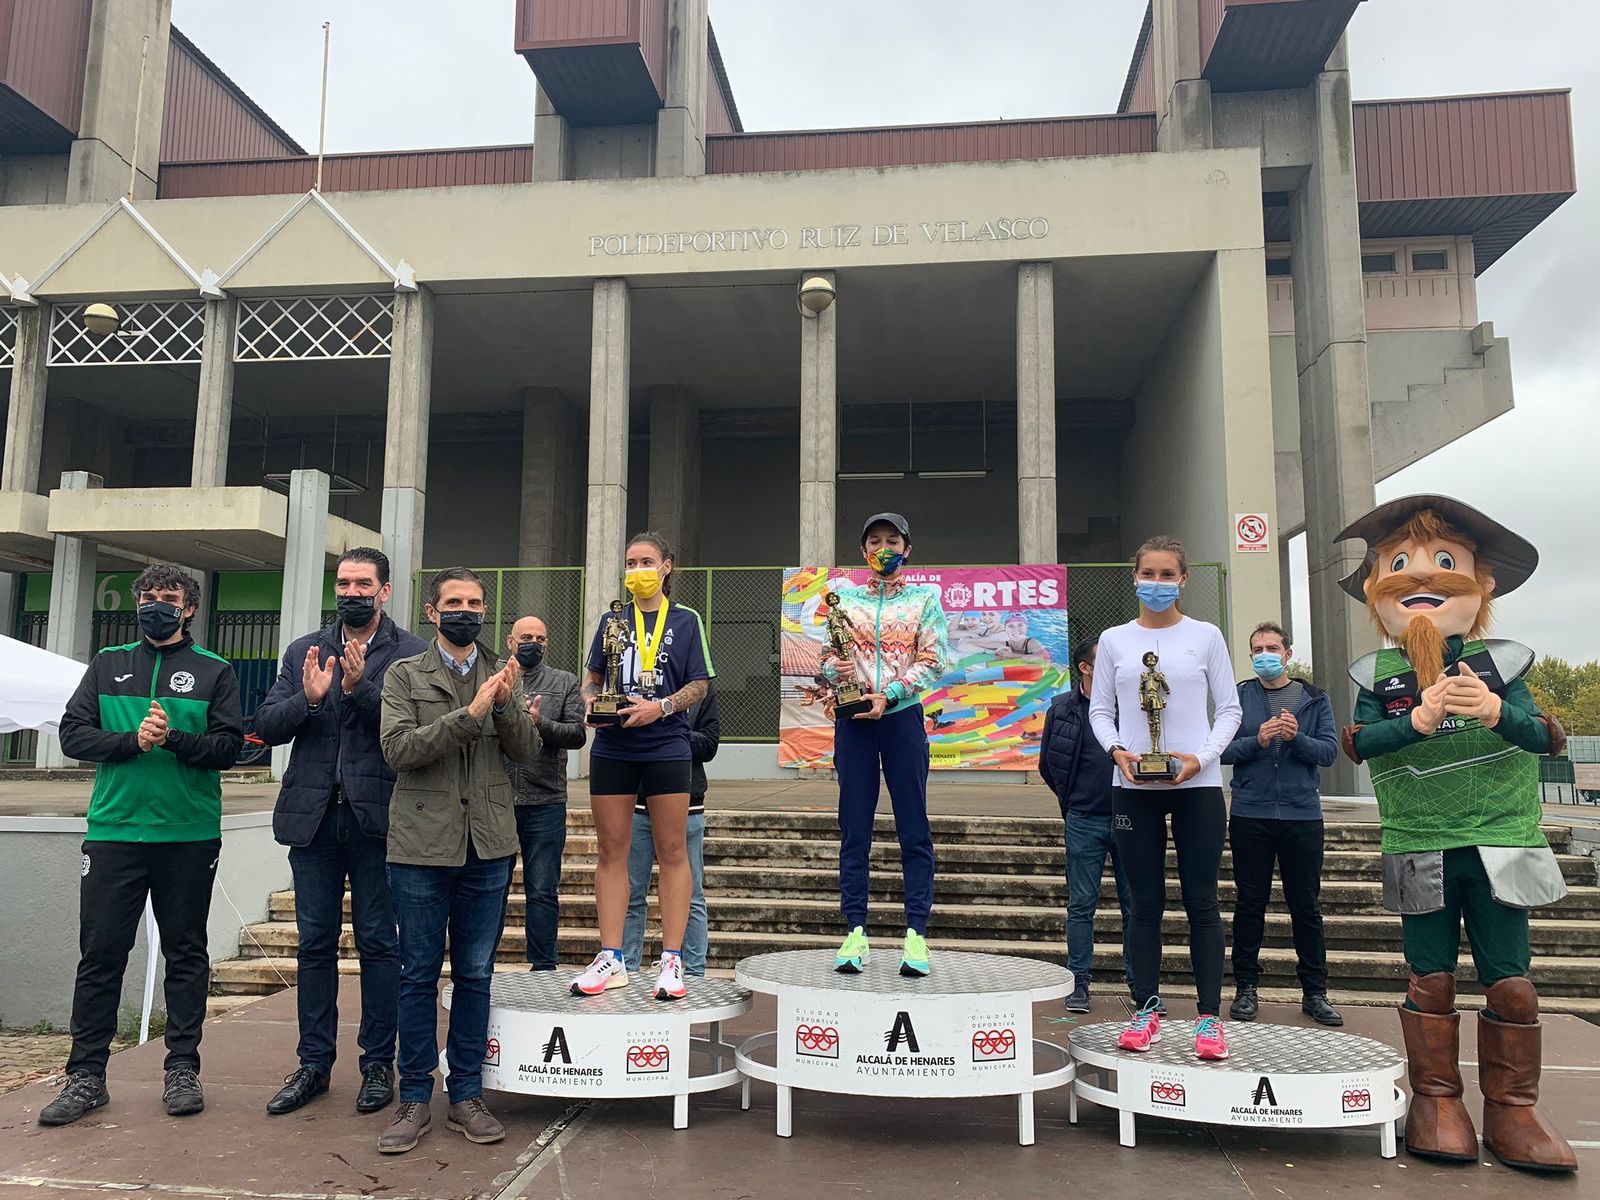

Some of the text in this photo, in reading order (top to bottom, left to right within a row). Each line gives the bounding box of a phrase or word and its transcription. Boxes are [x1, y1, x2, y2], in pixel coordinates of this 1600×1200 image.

[588, 216, 1050, 256] POLIDEPORTIVO RUIZ DE VELASCO
[929, 574, 942, 582] DE
[96, 574, 122, 612] 6
[796, 1008, 839, 1017] CIUDAD
[971, 1012, 1015, 1020] CIUDAD
[796, 1016, 839, 1025] DEPORTIVA
[796, 1058, 839, 1068] MUNICIPAL
[856, 1053, 955, 1066] ALCALÁ DE HENARES
[518, 1064, 603, 1077] ALCALÁ DE HENARES
[856, 1066, 955, 1077] AYUNTAMIENTO
[972, 1063, 1016, 1071] MUNICIPAL
[518, 1074, 603, 1086] AYUNTAMIENTO
[1230, 1106, 1257, 1114] ALCALÁ
[1270, 1108, 1303, 1116] HENARES
[1230, 1114, 1303, 1124] AYUNTAMIENTO
